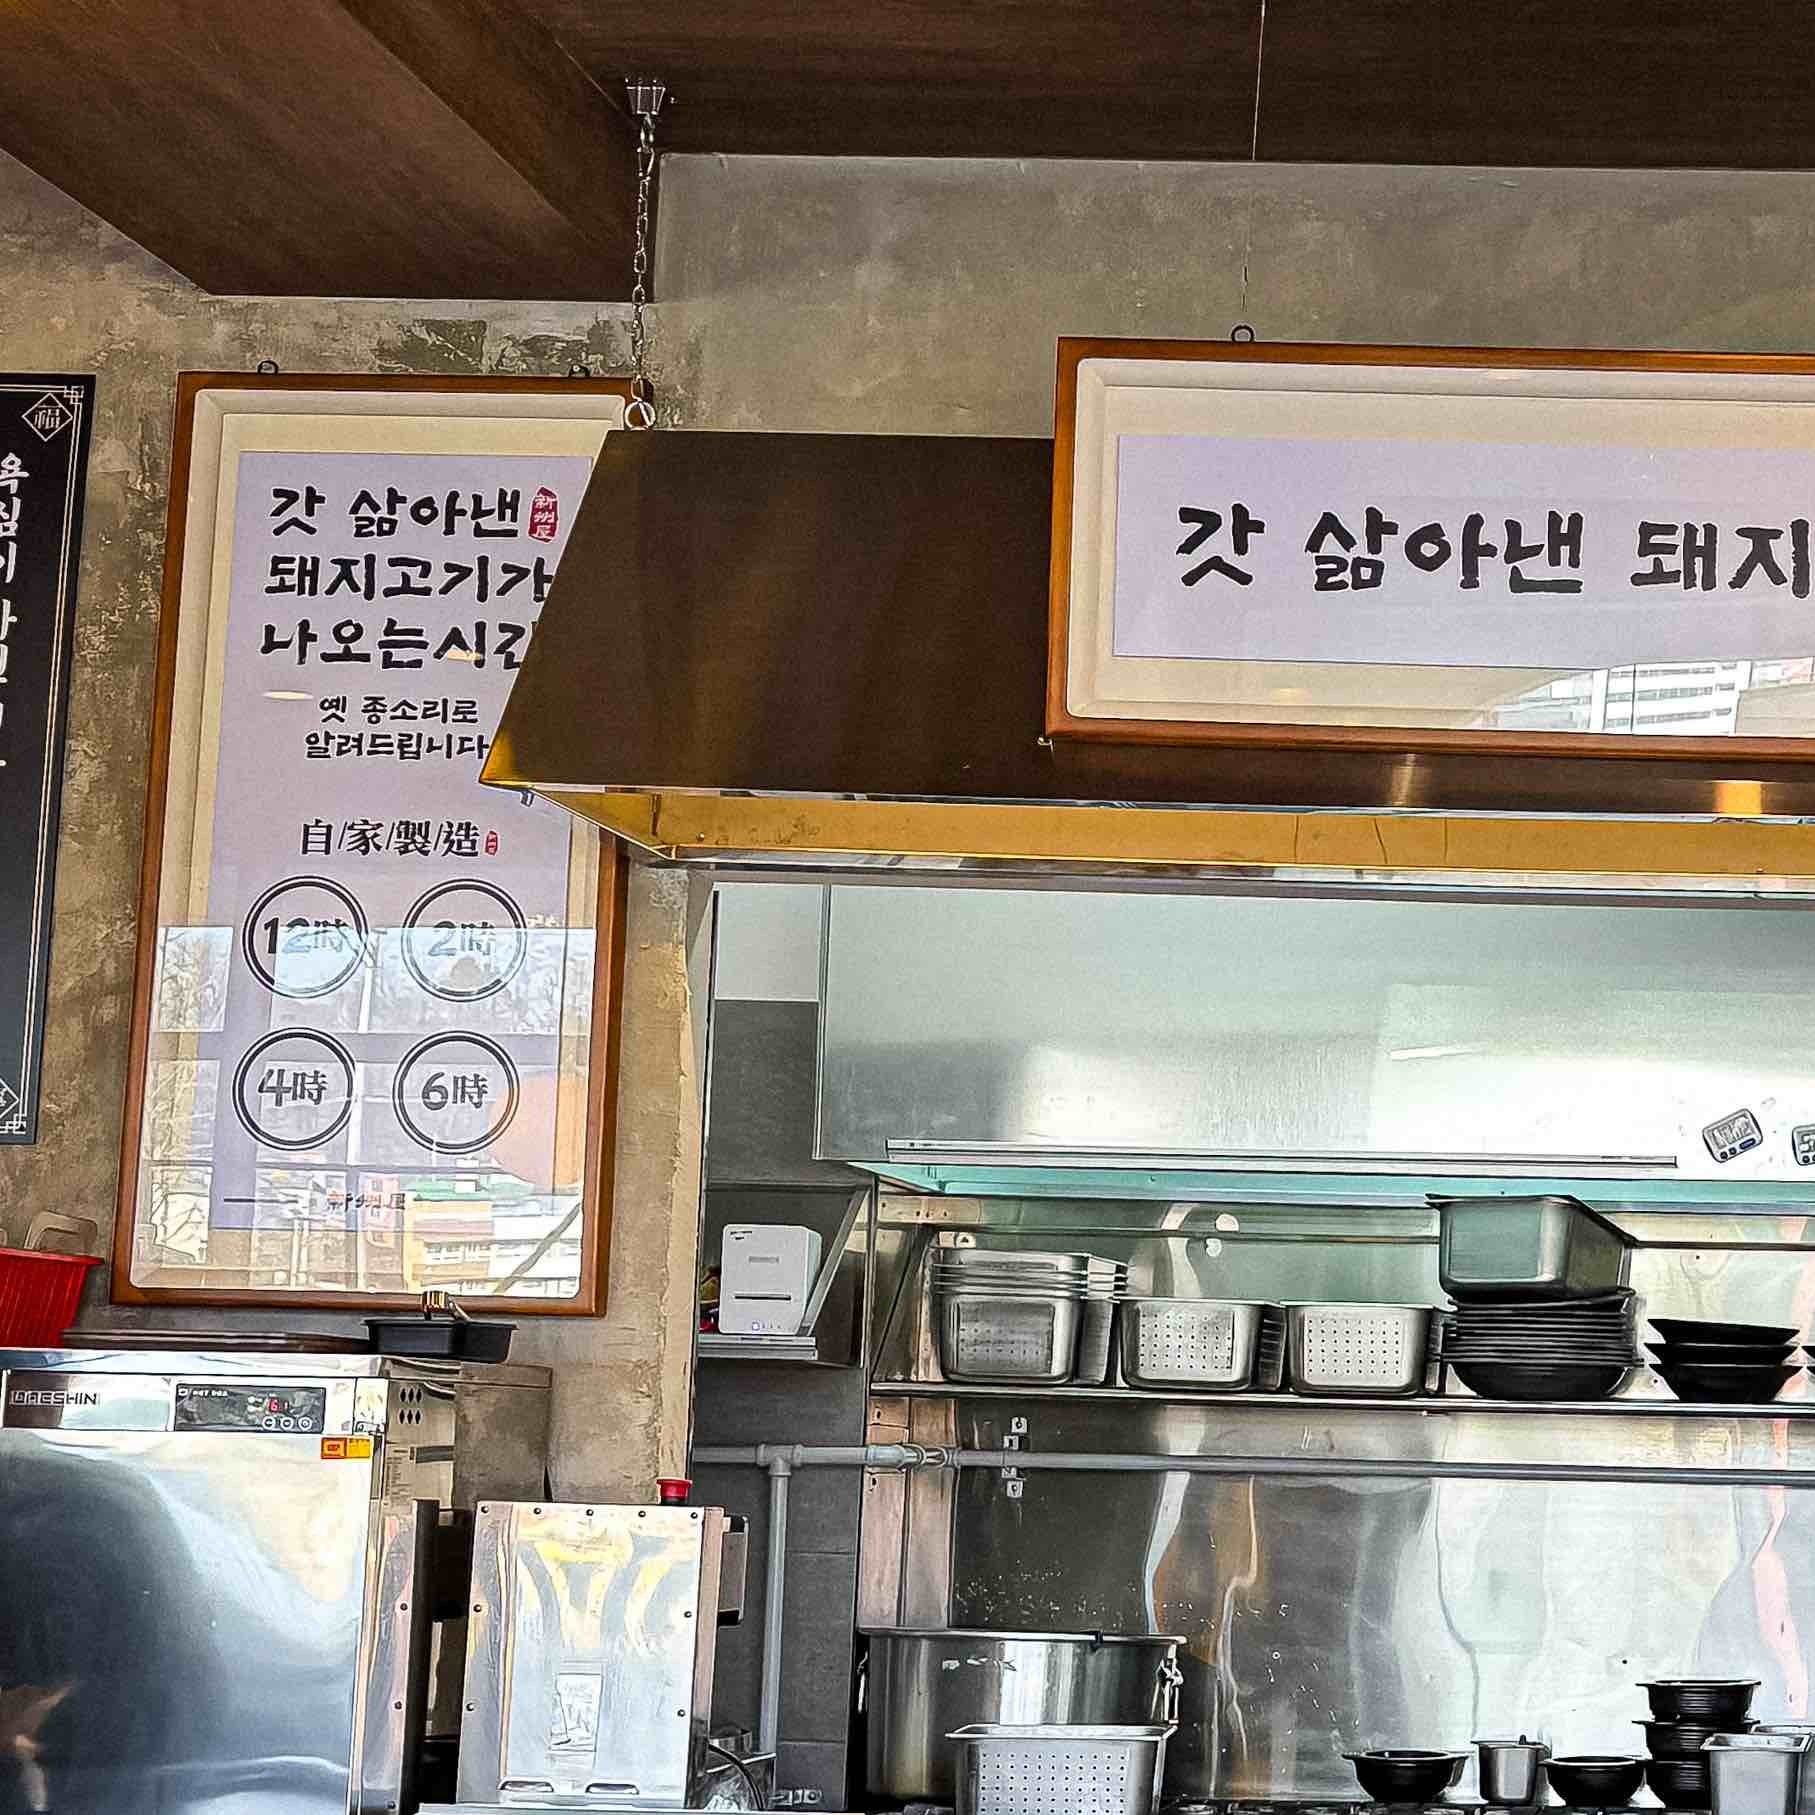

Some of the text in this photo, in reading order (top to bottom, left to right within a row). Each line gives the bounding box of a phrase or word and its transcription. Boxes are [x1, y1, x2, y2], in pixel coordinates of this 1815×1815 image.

[269, 485, 521, 538] 갓 삶아낸
[1176, 503, 1266, 590] 갓
[1304, 507, 1584, 597] 삶아낸
[264, 552, 554, 603] 돼지고기가
[318, 695, 480, 725] 옛 종소리로
[304, 731, 490, 761] 알려드립니다
[427, 920, 498, 959] 2時
[257, 1068, 328, 1108] 4時
[421, 1071, 490, 1112] 6時
